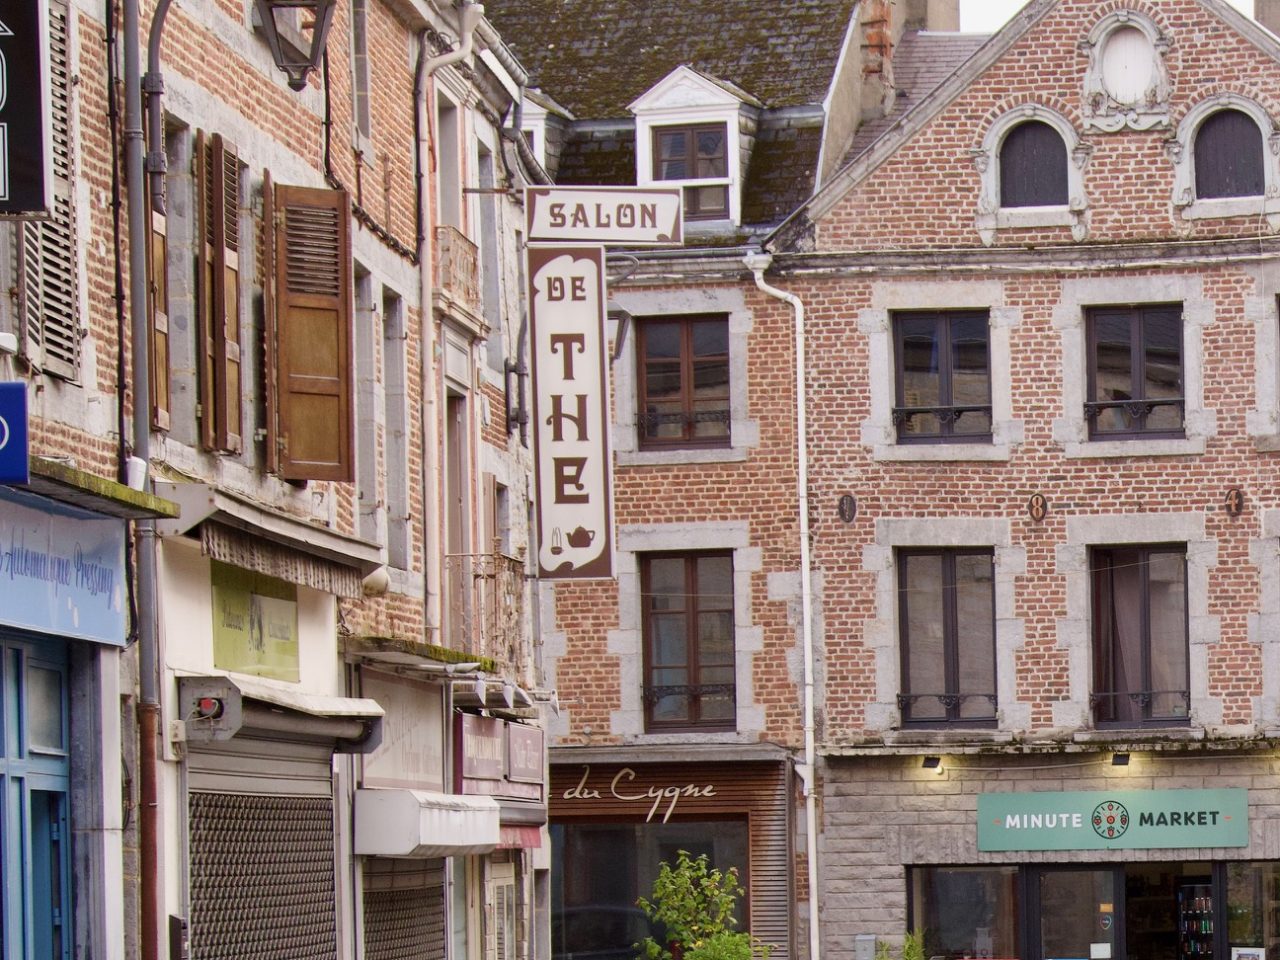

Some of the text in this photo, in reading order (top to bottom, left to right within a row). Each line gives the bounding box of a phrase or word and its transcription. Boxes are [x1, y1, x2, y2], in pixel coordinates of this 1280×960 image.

[549, 203, 658, 229] SALON
[547, 276, 587, 302] DE
[546, 333, 590, 504] THE
[1031, 495, 1043, 518] 8
[1225, 491, 1239, 512] 4
[73, 541, 114, 611] Pressing
[563, 765, 718, 825] du Cygne
[1005, 811, 1220, 829] MINUTE MARKET
